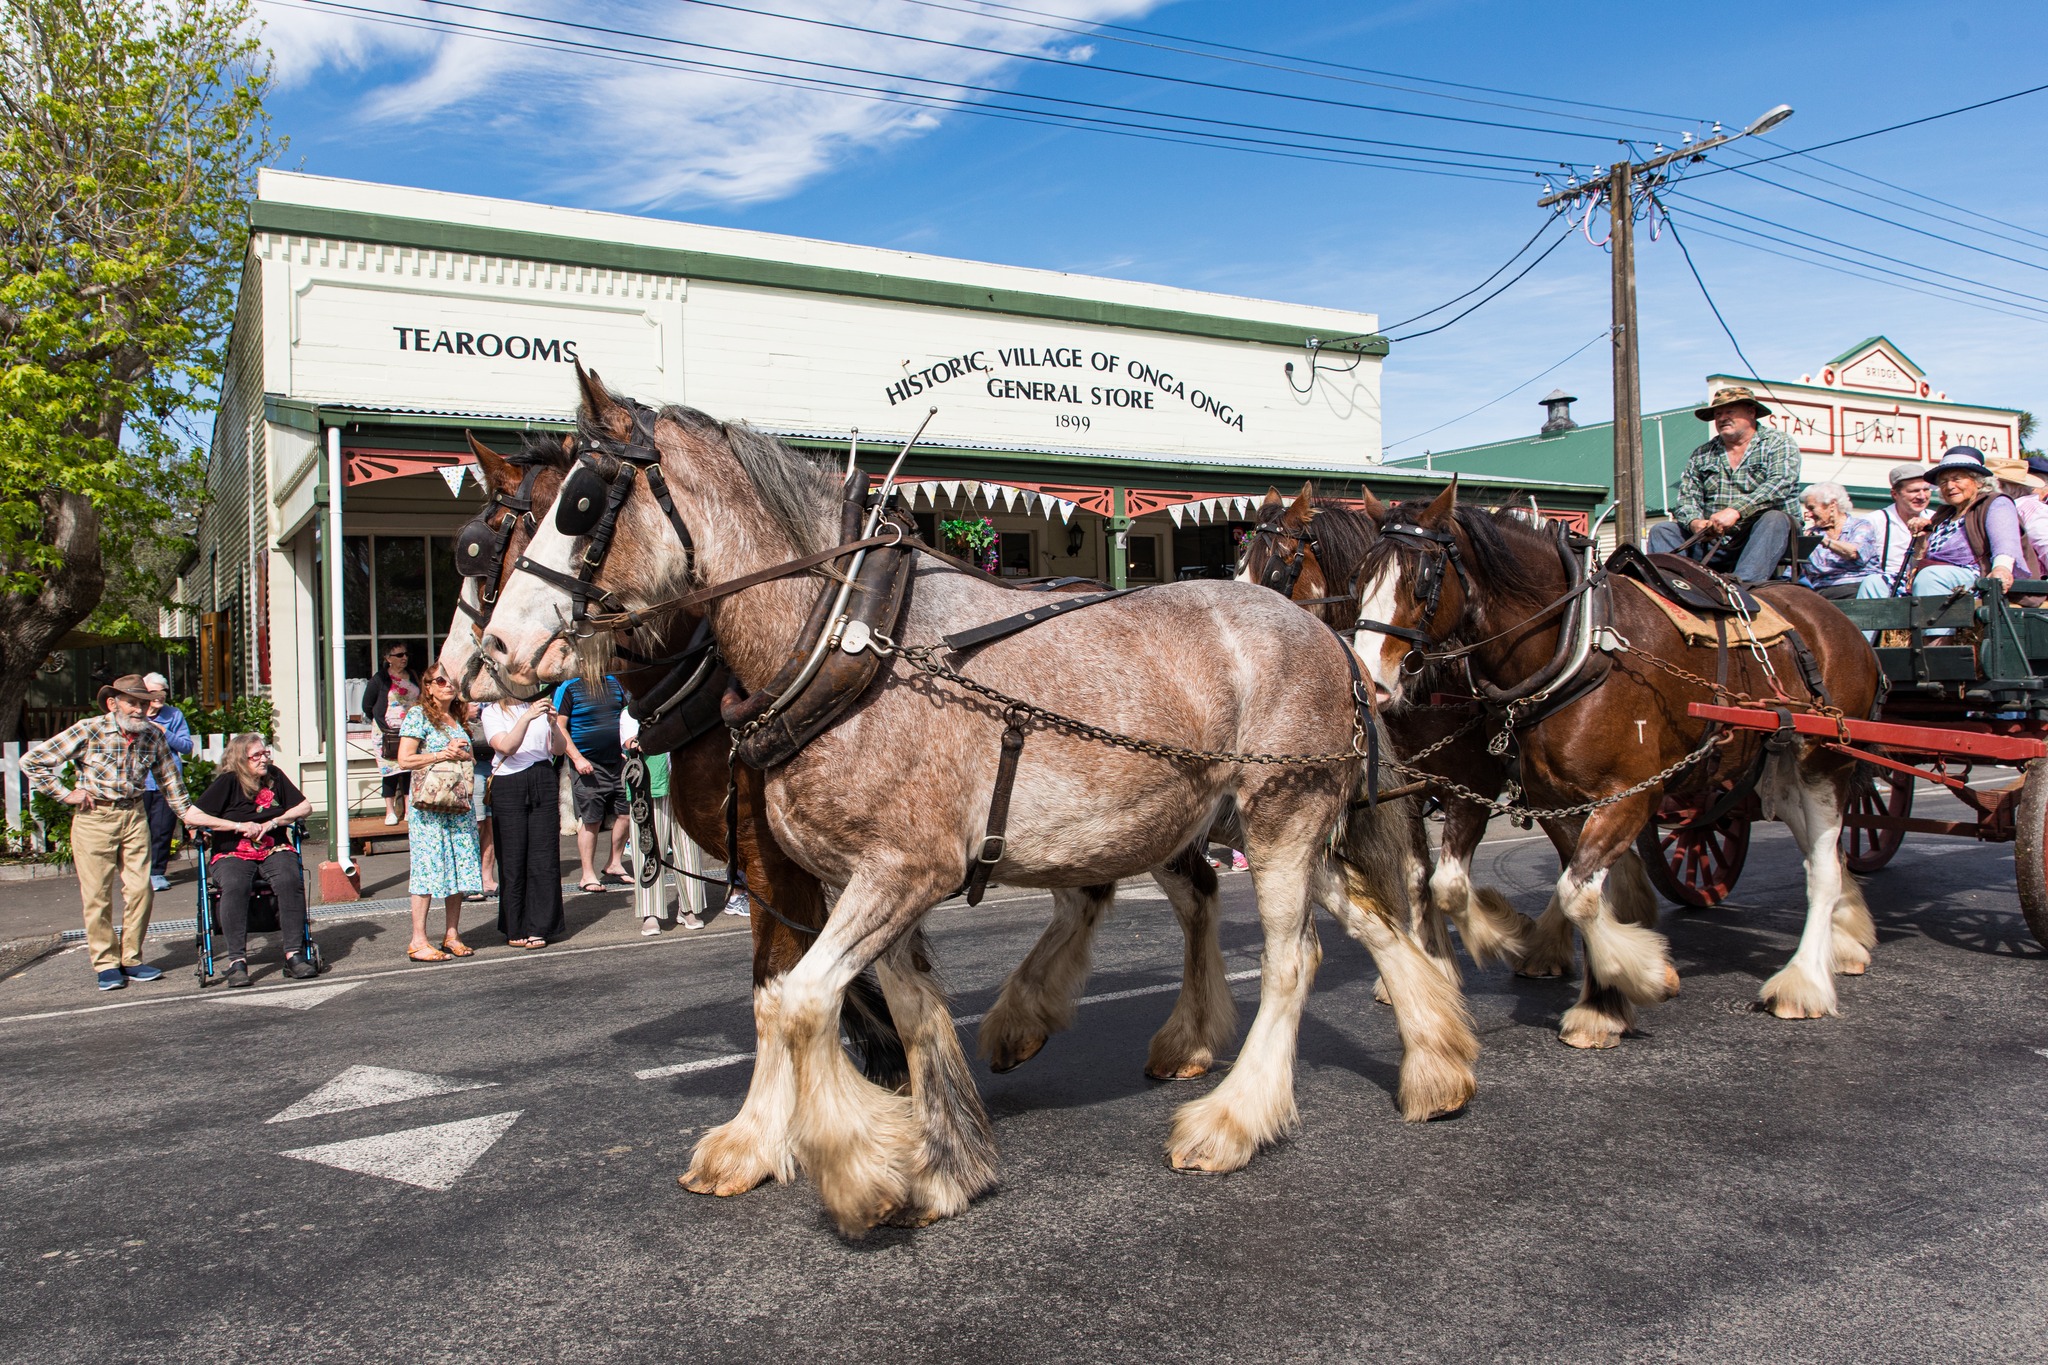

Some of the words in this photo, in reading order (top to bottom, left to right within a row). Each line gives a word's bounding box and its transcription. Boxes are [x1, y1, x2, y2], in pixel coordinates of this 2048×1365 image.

[392, 326, 577, 363] TEAROOMS
[1865, 366, 1898, 379] BRIDGE
[885, 350, 988, 406] HISTORIC
[998, 347, 1083, 369] VILLAGE
[1091, 351, 1120, 373] OF
[1127, 360, 1185, 400] ONGA
[1190, 389, 1244, 433] ONGA
[986, 377, 1083, 405] GENERAL
[1091, 386, 1155, 410] STORE
[1055, 414, 1091, 434] 1899
[1769, 414, 1816, 436] STAY
[1873, 425, 1905, 444] ART
[1955, 432, 1999, 453] YOGA
[1633, 719, 1647, 744] T
